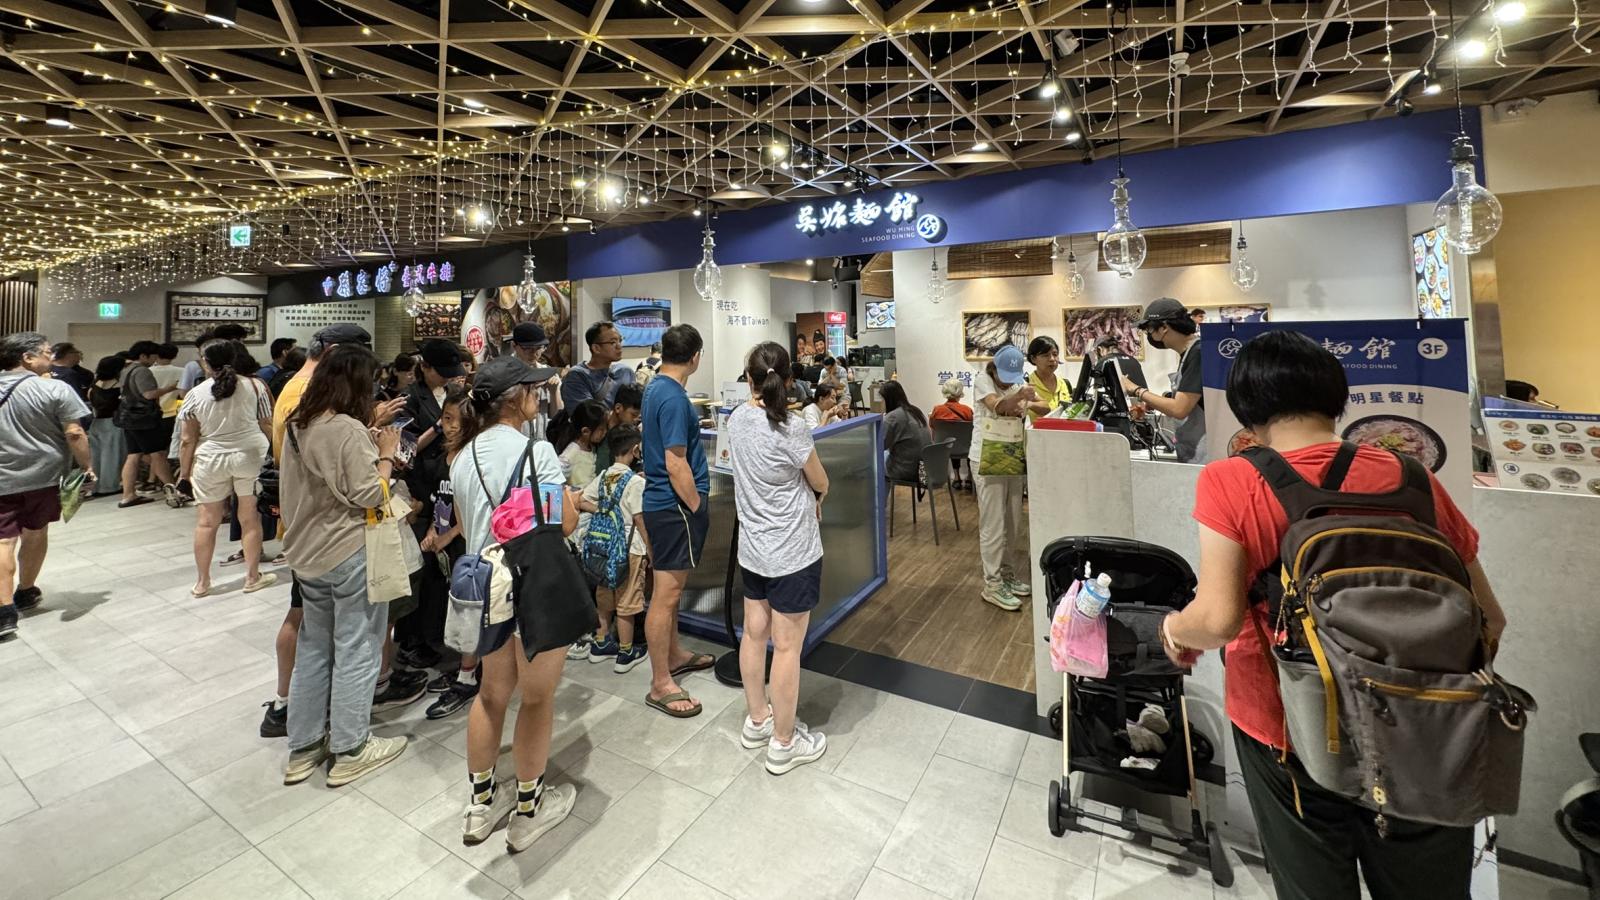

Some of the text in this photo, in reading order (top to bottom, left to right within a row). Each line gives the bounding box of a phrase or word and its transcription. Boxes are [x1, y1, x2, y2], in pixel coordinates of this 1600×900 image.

[861, 232, 915, 243] SEAFOOD DINING
[1320, 337, 1396, 361] 麵館
[1422, 342, 1444, 355] 3F
[1350, 391, 1424, 405] 明星餐點
